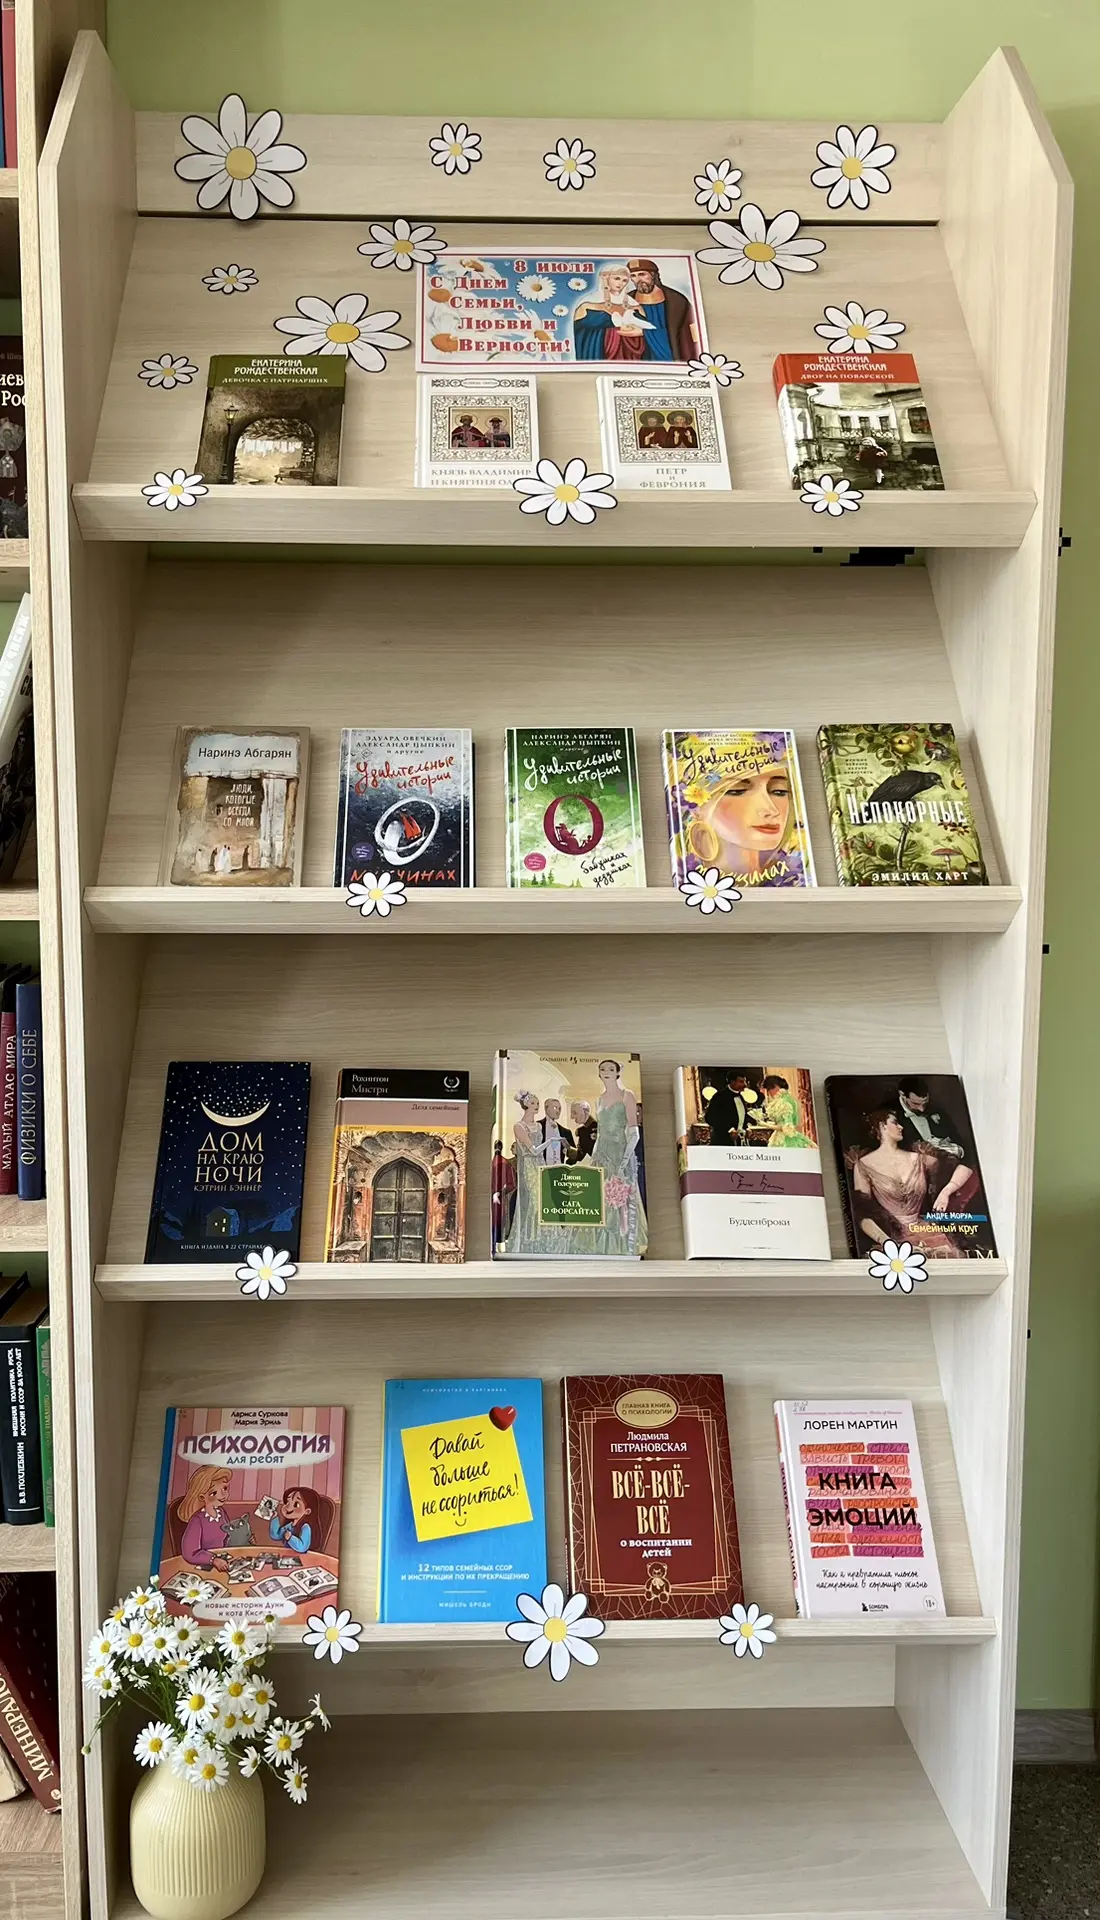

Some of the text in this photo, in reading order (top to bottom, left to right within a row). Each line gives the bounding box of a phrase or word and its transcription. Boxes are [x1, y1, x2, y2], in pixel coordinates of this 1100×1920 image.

[513, 260, 527, 273] 8
[430, 276, 443, 289] С
[251, 359, 303, 367] ЕКАТЕРИНА
[818, 356, 870, 364] ЕКАТЕРИНА
[234, 367, 318, 376] РОЖДЕСТВЕНСКАЯ
[803, 363, 888, 372] РОЖДЕСТВЕНСКАЯ
[198, 748, 292, 759] Наринэ Абгарян
[354, 756, 455, 796] Удивительные
[523, 748, 624, 792] Удивительные
[396, 772, 452, 795] истории
[566, 765, 621, 790] истории
[872, 872, 969, 882] ЭМИЛИЯ ХАРТ
[351, 1084, 389, 1096] Мистри
[1, 1034, 17, 1170] МАЛЫЙ АТЛАС МИРА
[20, 1029, 37, 1165] ФИЗИКИ О СЕБЕ
[198, 1132, 264, 1152] ДОМ
[197, 1153, 264, 1165] НА КРАЮ
[726, 1152, 782, 1162] Томас Манн
[195, 1166, 262, 1184] НОЧИ
[194, 1184, 262, 1192] КЭТРИН БЭННЕР
[550, 1207, 600, 1216] ФОРСАЙТАХ
[728, 1217, 790, 1228] Будденброки
[908, 1222, 979, 1235] Семейный круг
[231, 1410, 289, 1419] Лариса Суркова
[234, 1418, 258, 1426] Мария
[803, 1420, 898, 1430] ЛОРЕН МАРТИН
[626, 1432, 670, 1440] Людмила
[182, 1435, 331, 1454] ПСИХОЛОГИЯ
[429, 1432, 485, 1460] Давай
[610, 1442, 688, 1452] ПЕТРАНОВСКАЯ
[226, 1454, 285, 1466] для ребят
[430, 1460, 491, 1487] больше
[611, 1464, 692, 1500] ВСЁ-ВСЁ-
[819, 1472, 897, 1490] КНИГА
[421, 1473, 520, 1518] не ссориться!
[636, 1500, 671, 1535] ВСЁ
[808, 1503, 916, 1530] ЭМОЦИЙ
[628, 1538, 693, 1548] воспитании
[642, 1548, 672, 1558] детей
[418, 1563, 430, 1572] 12
[456, 1564, 494, 1572] СЕМЕЙНЫХ
[408, 1574, 454, 1582] ИНСТРУКЦИИ
[925, 1599, 936, 1608] 18+
